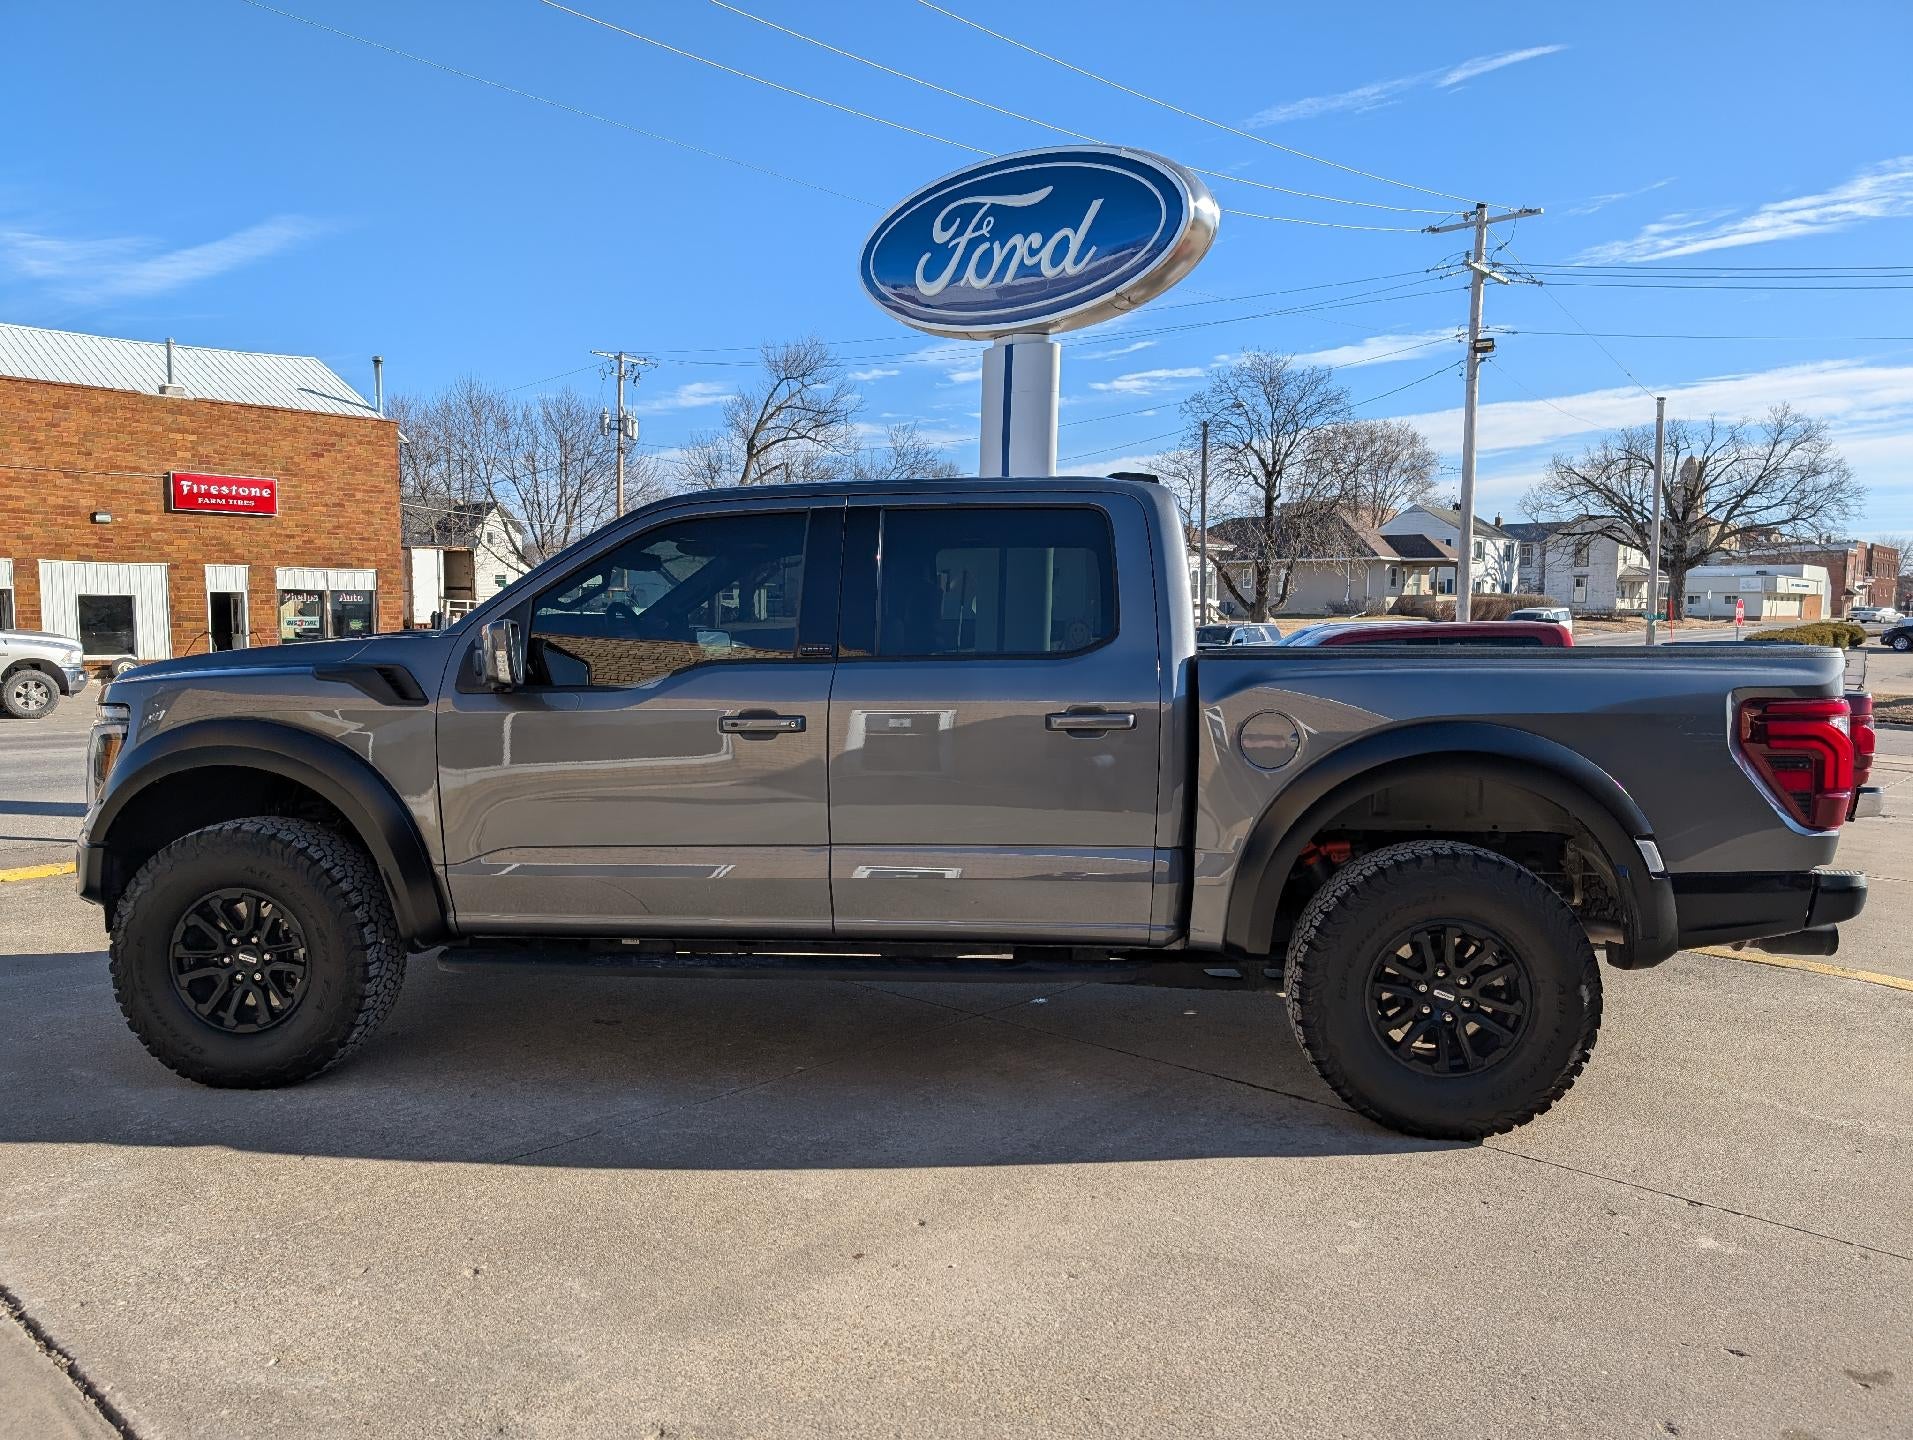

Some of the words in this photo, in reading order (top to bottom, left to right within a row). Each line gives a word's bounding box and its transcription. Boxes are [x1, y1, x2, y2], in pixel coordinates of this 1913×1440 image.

[916, 185, 1104, 296] Ford
[180, 480, 272, 498] Firestone
[197, 497, 226, 505] FARM
[227, 499, 256, 507] TIRES
[338, 593, 364, 602] Auto
